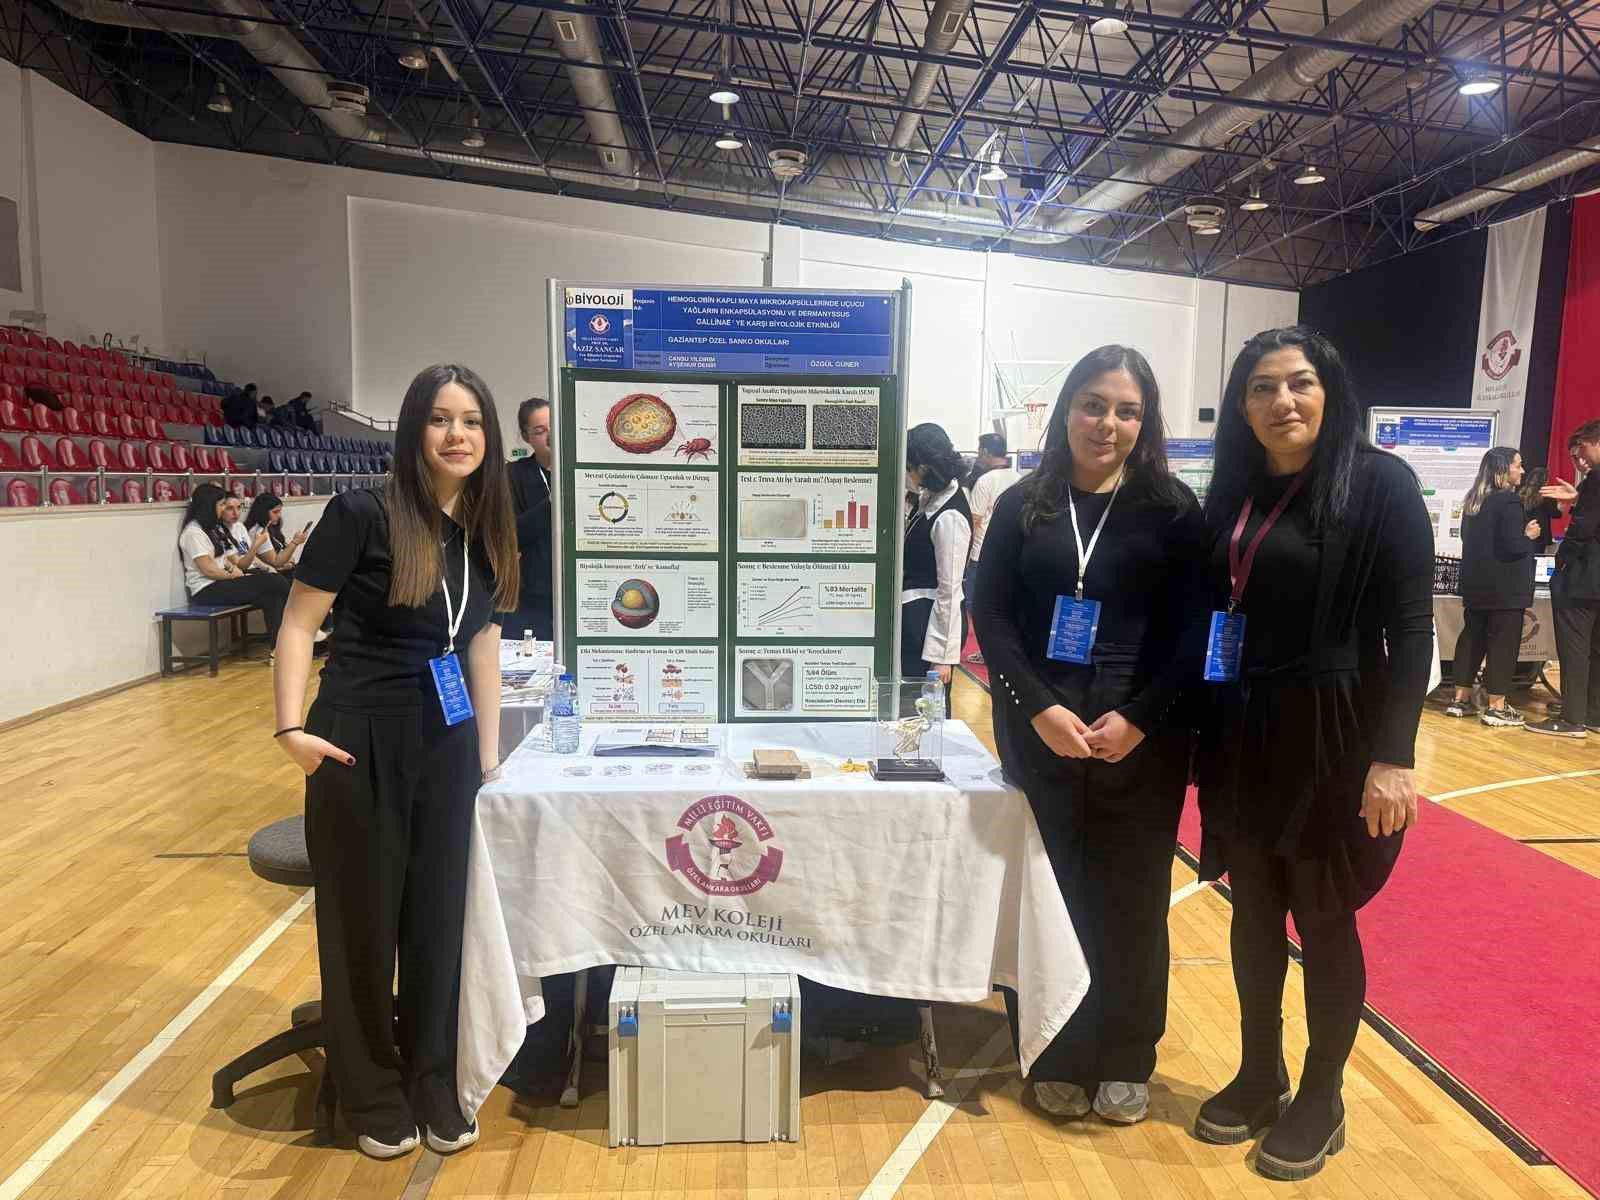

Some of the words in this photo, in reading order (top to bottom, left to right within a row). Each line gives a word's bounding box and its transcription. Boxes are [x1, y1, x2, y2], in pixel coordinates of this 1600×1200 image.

[575, 292, 624, 306] BİYOLOJİ
[668, 296, 716, 304] HEMOGLOBİN
[668, 336, 708, 344] GAZİANTEP
[708, 336, 726, 344] ÖZEL
[684, 803, 706, 826] MİLLİ
[706, 798, 744, 813] EĞİTİM
[747, 811, 769, 836] VAKFI
[686, 866, 701, 884] ÖZEL
[700, 881, 731, 893] ANKARA
[660, 903, 706, 922] MEV
[714, 908, 784, 932] KOLEJİ
[629, 924, 671, 938] ÖZEL
[671, 923, 733, 938] ANKARA
[736, 930, 814, 949] OKULLARI
